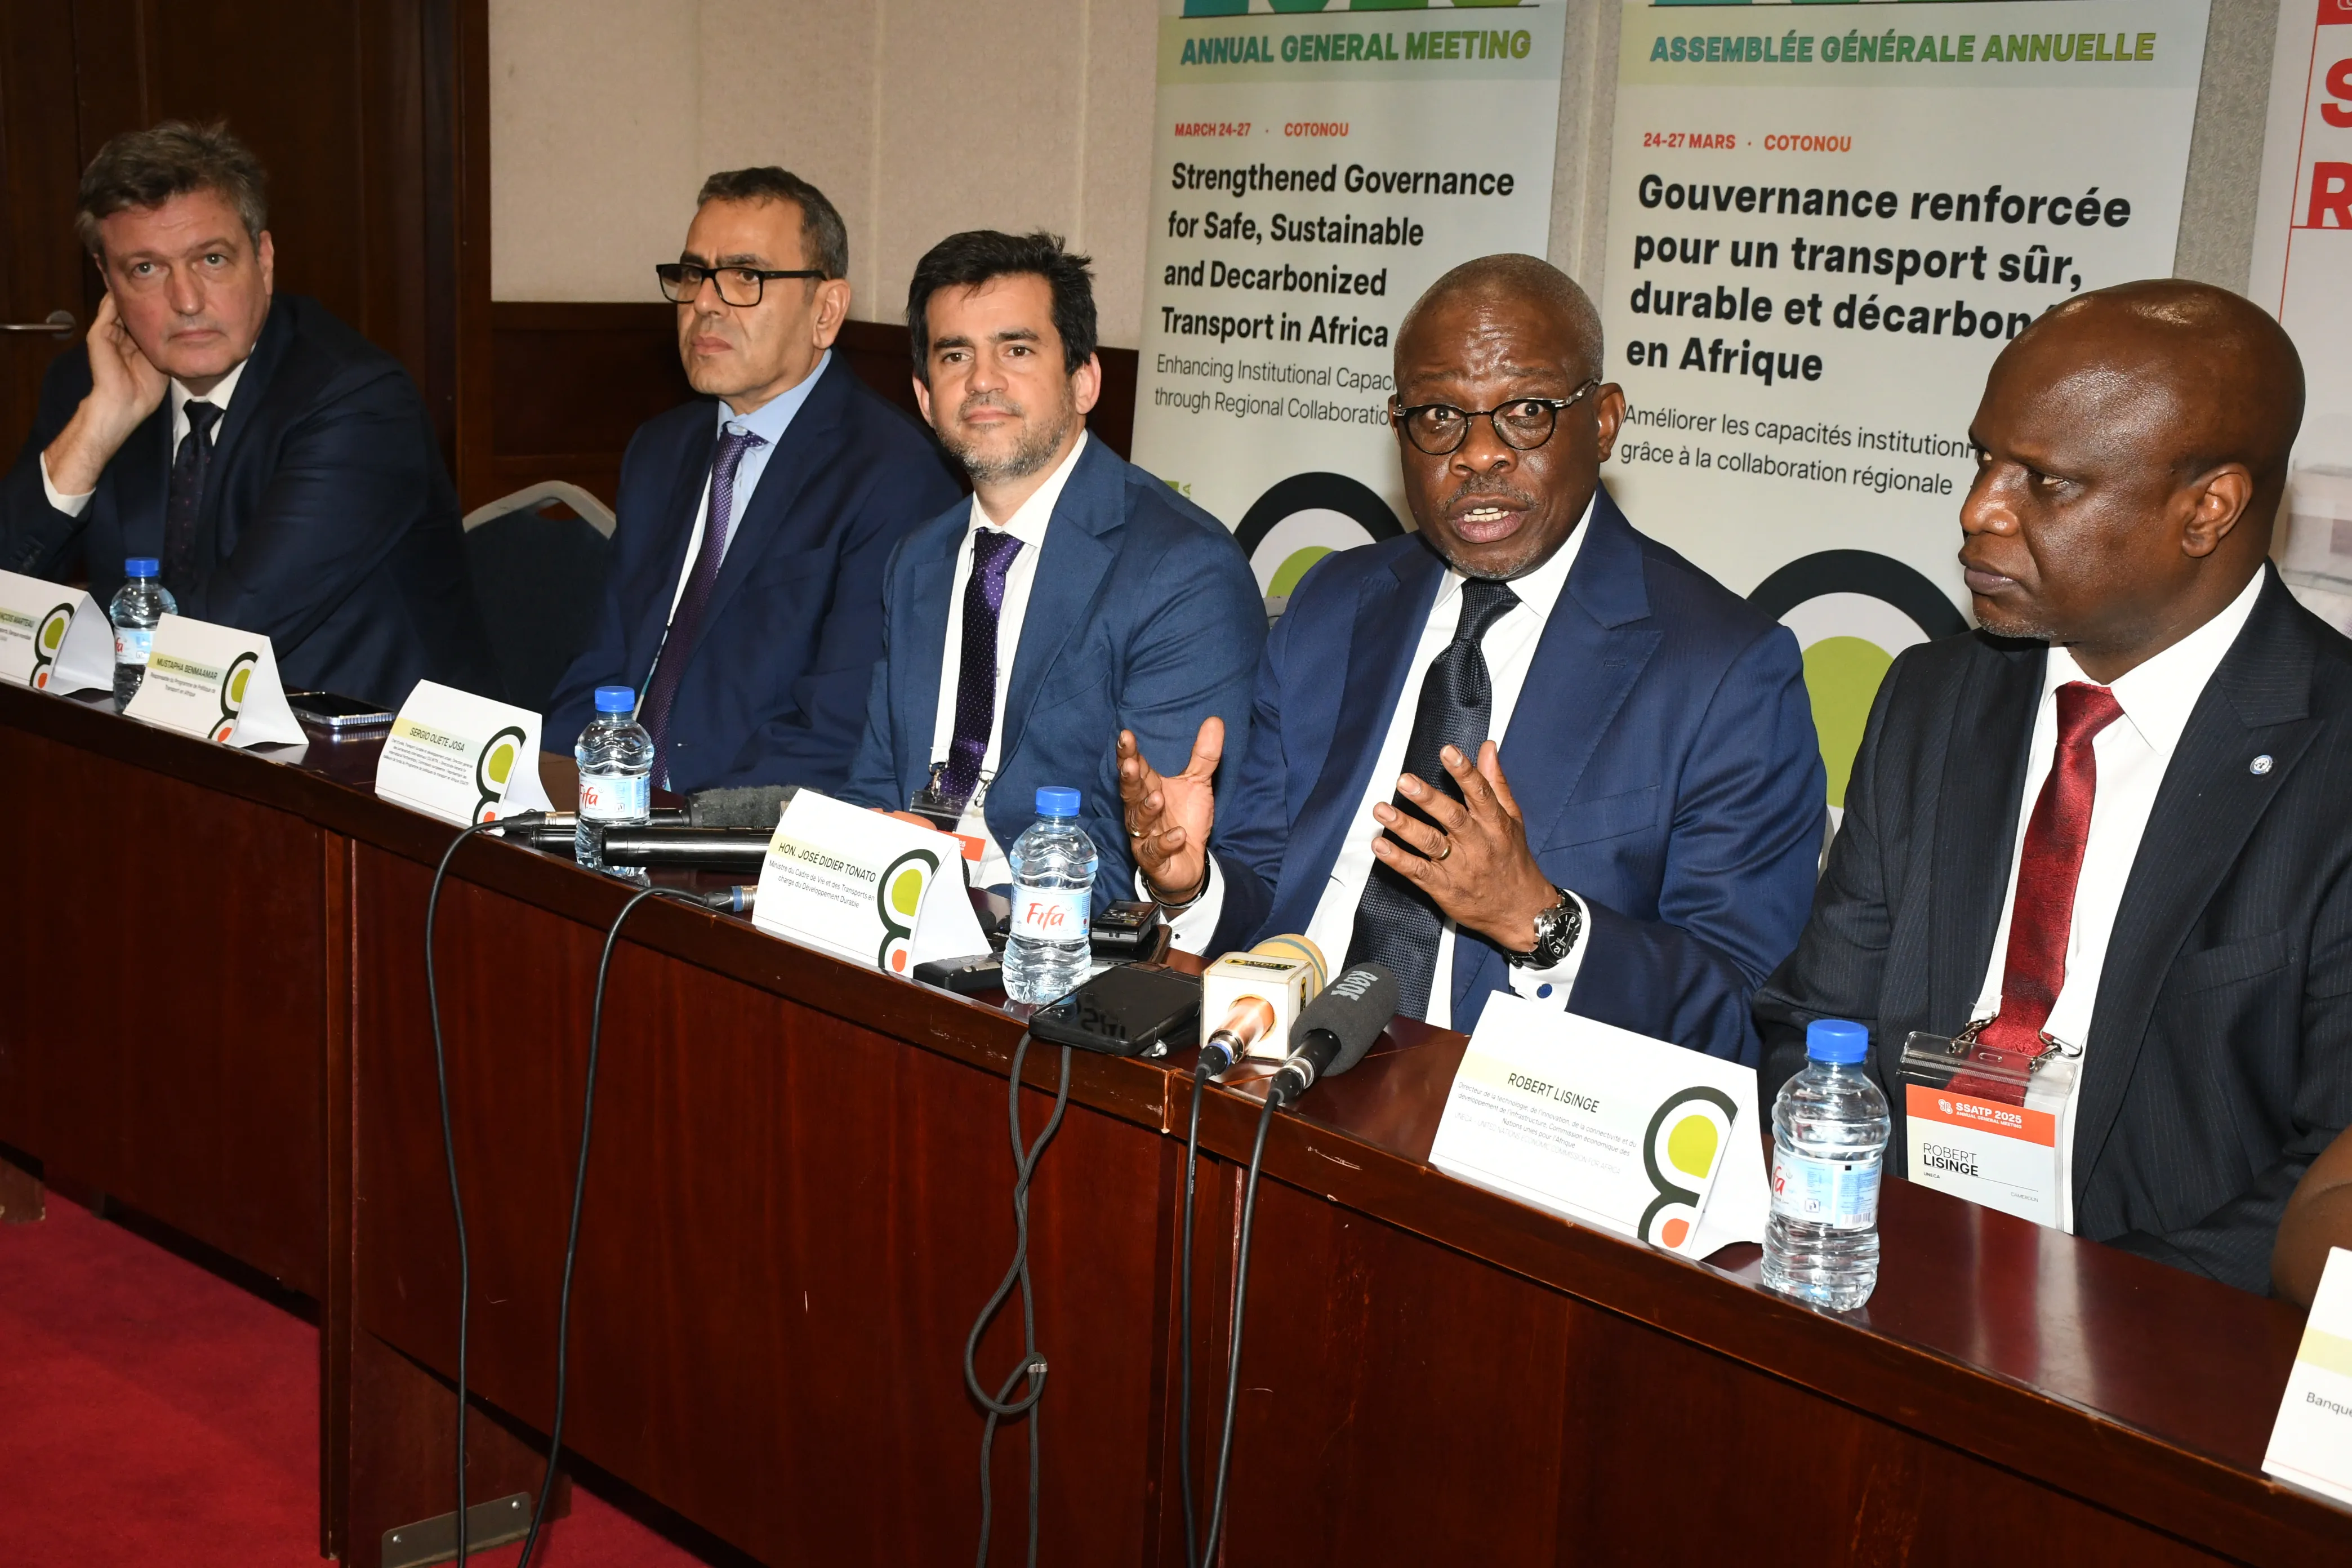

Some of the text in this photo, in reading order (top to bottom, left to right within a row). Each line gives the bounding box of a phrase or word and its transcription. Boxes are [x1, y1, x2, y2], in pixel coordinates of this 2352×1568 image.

[1180, 30, 1531, 65] ANNUAL GENERAL MEETING
[1650, 29, 2156, 63] ASSEMBLÉE GÉNÉRALE ANNUELLE
[1175, 123, 1348, 136] MARCH 24-27 COTONOU
[1643, 133, 1851, 152] 24-27 MARS COTONOU
[1172, 163, 1513, 197] Strengthened Governance
[1640, 175, 2130, 227] Gouvernance renforcée
[1169, 211, 1423, 246] for Safe, Sustainable
[1165, 260, 1387, 296] and Decarbonized
[1634, 236, 2082, 292] pour un transport sûr,
[1162, 307, 1388, 347] Transport in Africa
[1631, 281, 2034, 342] durable et décarbon
[1157, 354, 1395, 394] Enhancing Institutional Capaci
[1627, 337, 1822, 386] en Afrique
[1155, 387, 1389, 425] through Regional Collaboratio
[1624, 404, 1978, 460] Améliorer les capacités institutionn
[1622, 442, 1952, 495] grâce à la collaboration régionale
[410, 728, 465, 752] SERGIO OLIETE JOSA
[769, 859, 788, 872] Ministre
[795, 869, 809, 879] Cadre
[842, 884, 867, 899] Transports
[778, 843, 876, 882] HON. JOSÉ DIDIER TONATO
[778, 876, 794, 886] charge
[840, 896, 859, 908] Durable
[1027, 903, 1064, 930] Fifa
[1459, 1082, 1482, 1094] Directeur
[1508, 1073, 1600, 1113] ROBERT LISINGE
[1503, 1118, 1522, 1129] Nations
[1955, 1102, 2022, 1124] SSATP 2025
[1956, 1111, 2022, 1129] ANNUAL GENERAL MEETING
[1549, 1124, 1582, 1139] Commission
[1923, 1143, 1977, 1164] ROBERT
[1923, 1154, 1979, 1177] LISINGE
[1774, 1166, 1785, 1195] fa
